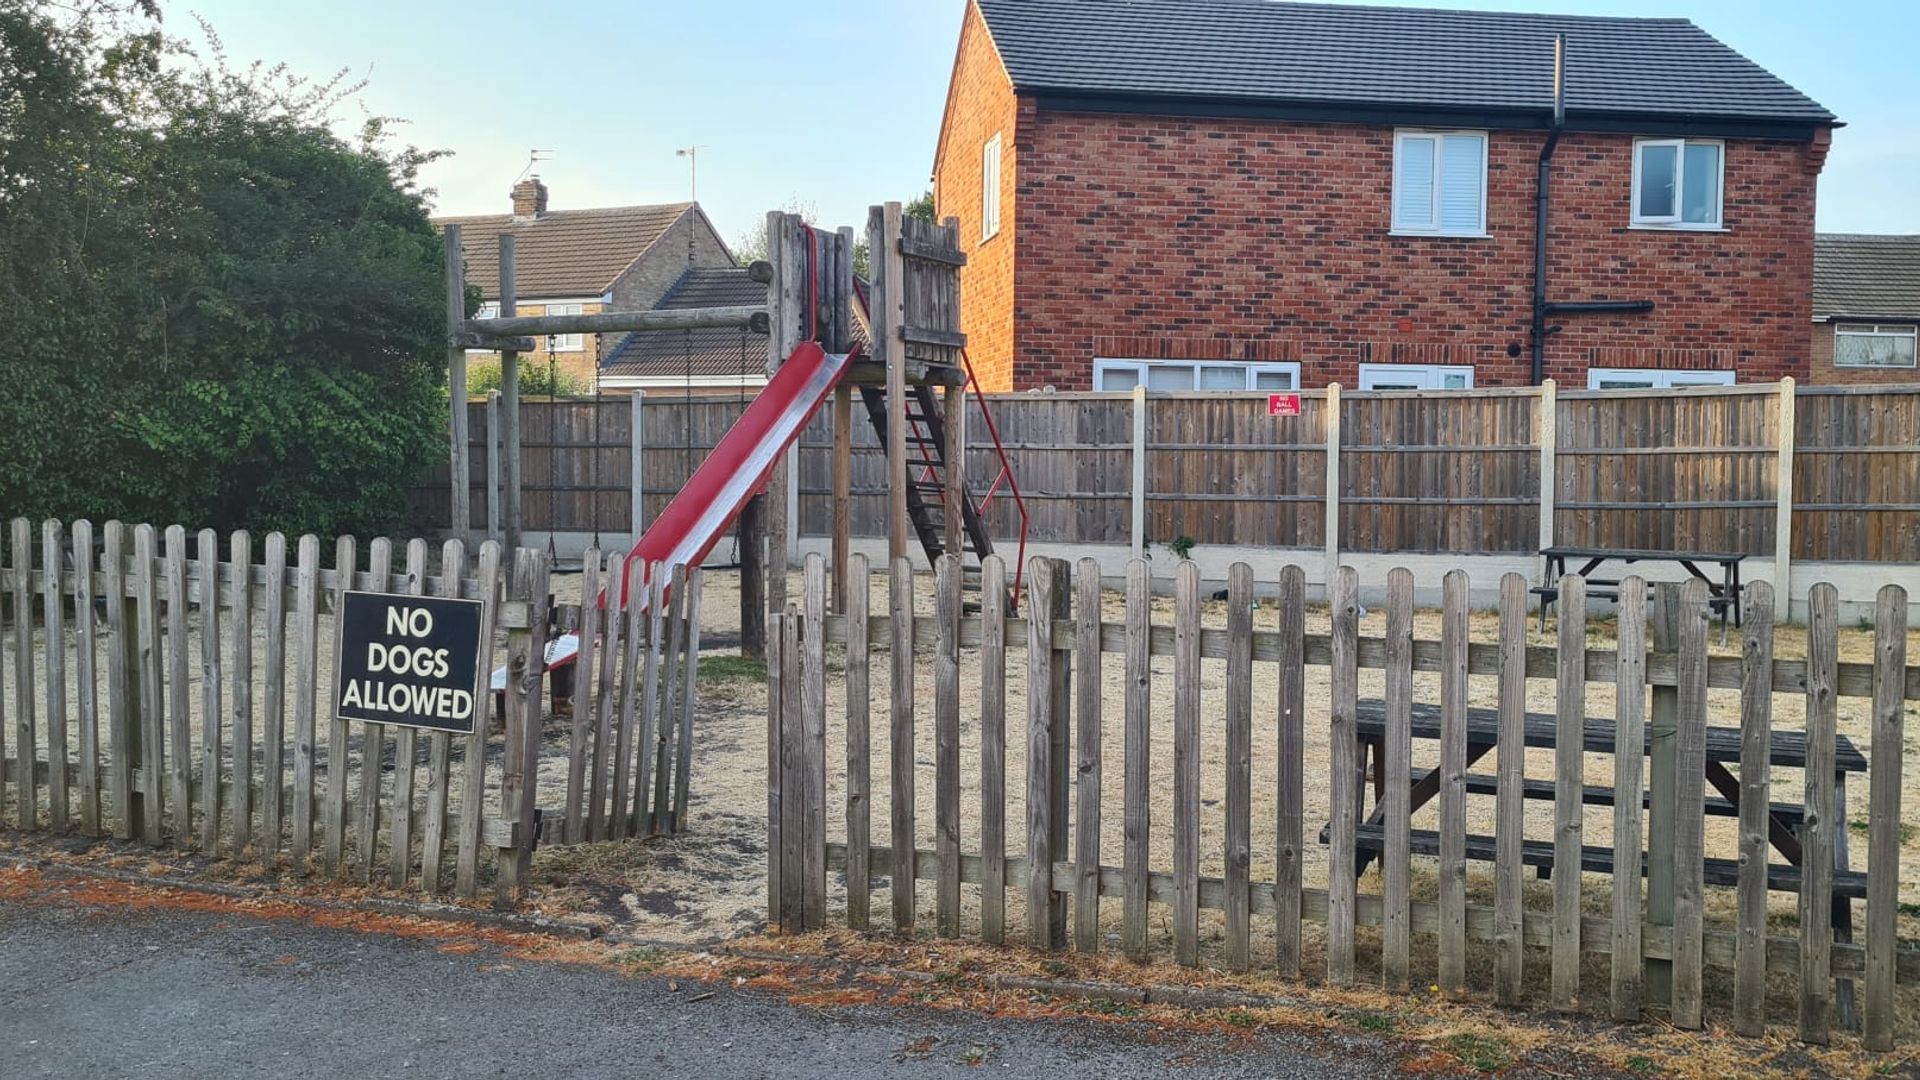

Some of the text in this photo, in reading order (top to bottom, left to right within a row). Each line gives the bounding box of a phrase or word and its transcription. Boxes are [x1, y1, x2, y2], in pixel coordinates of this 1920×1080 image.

[386, 605, 433, 638] NO
[367, 642, 449, 679] DOGS
[341, 678, 473, 720] ALLOWED
